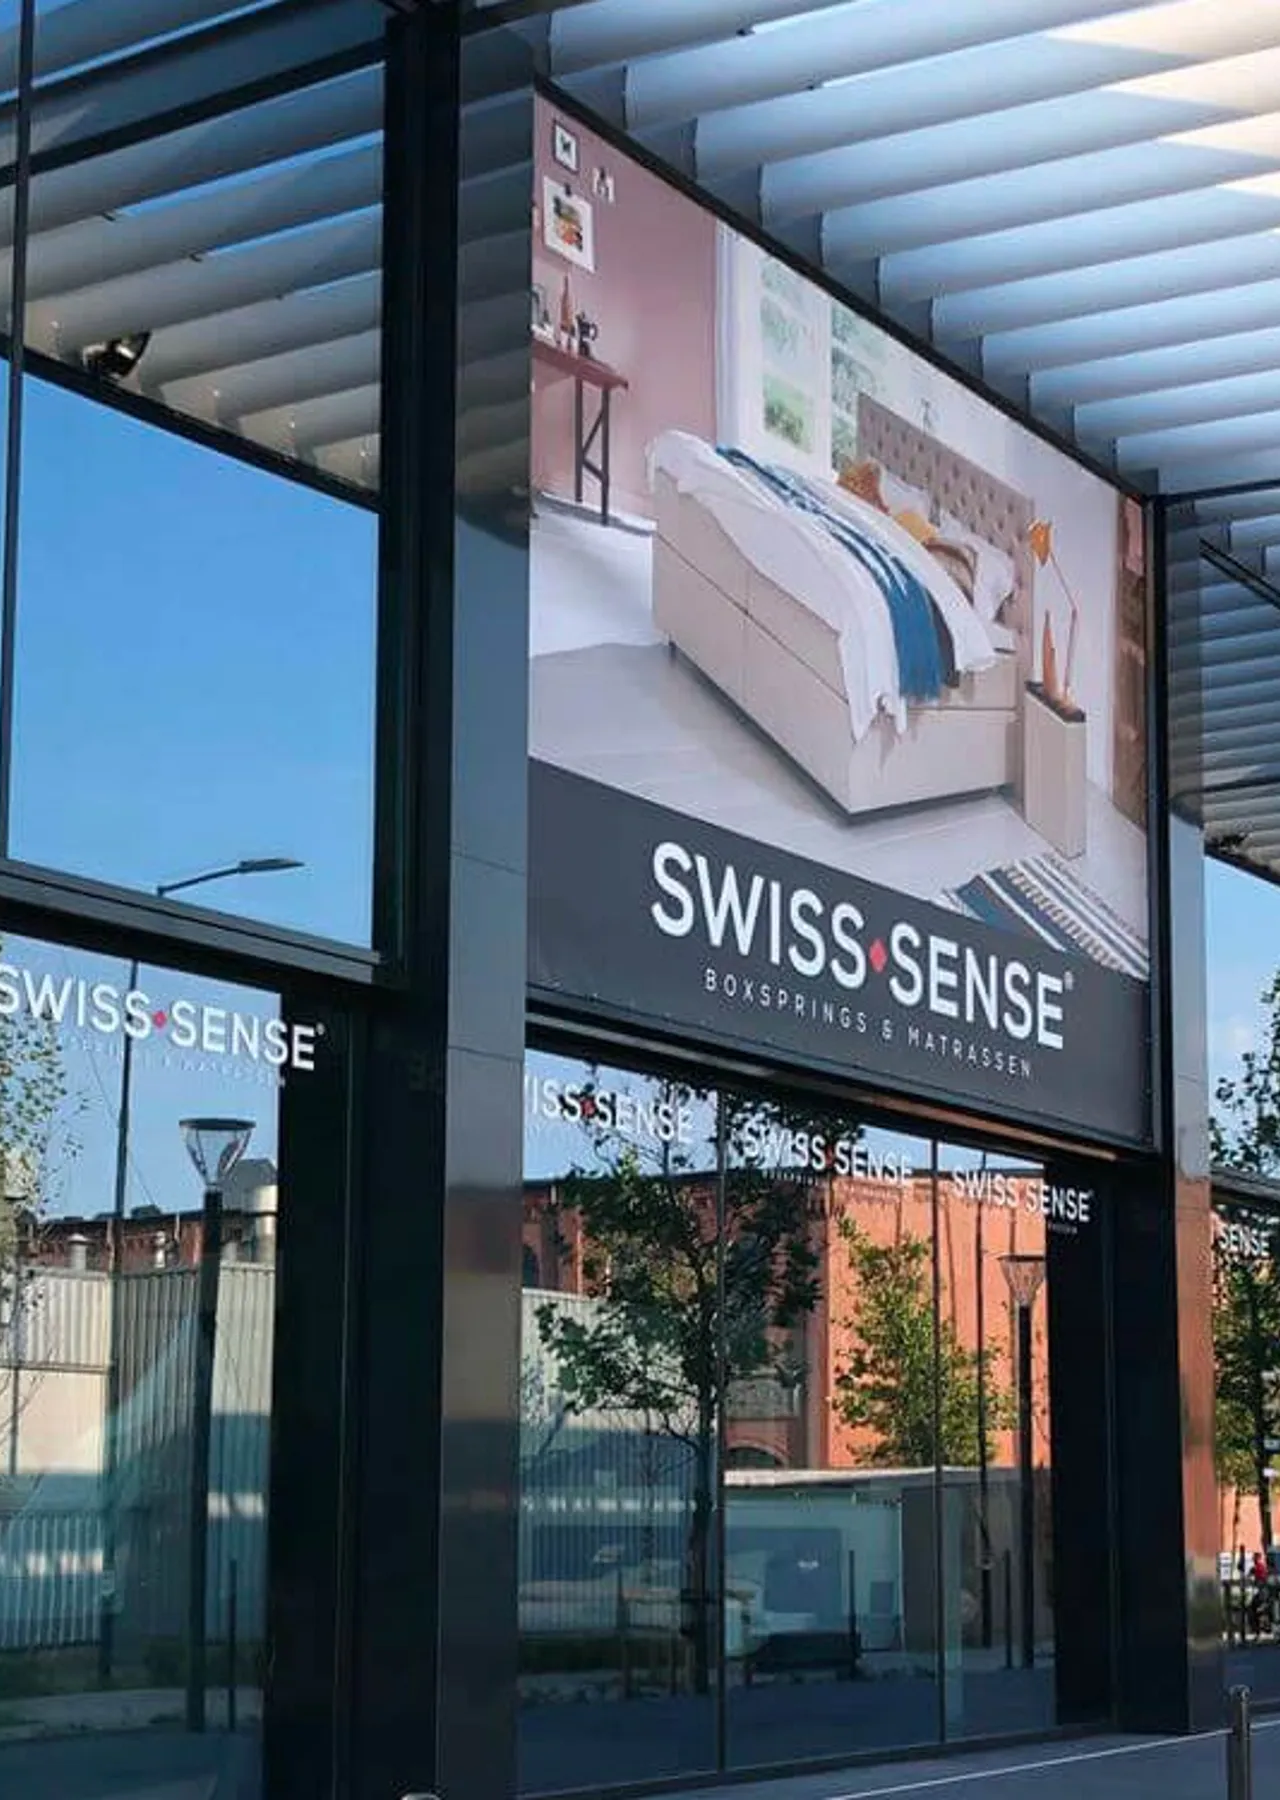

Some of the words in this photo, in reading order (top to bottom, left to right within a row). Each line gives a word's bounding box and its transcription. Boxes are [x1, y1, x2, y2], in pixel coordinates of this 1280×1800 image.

[651, 841, 866, 989] SWISS
[705, 968, 868, 1033] BOXSPRINGS
[907, 1025, 1031, 1077] MATRASSEN
[524, 1074, 583, 1123] ISS
[594, 1089, 694, 1144] SENSE
[744, 1121, 826, 1170] SWISS
[952, 1166, 1019, 1208] SWISS
[1025, 1181, 1090, 1222] SENSE
